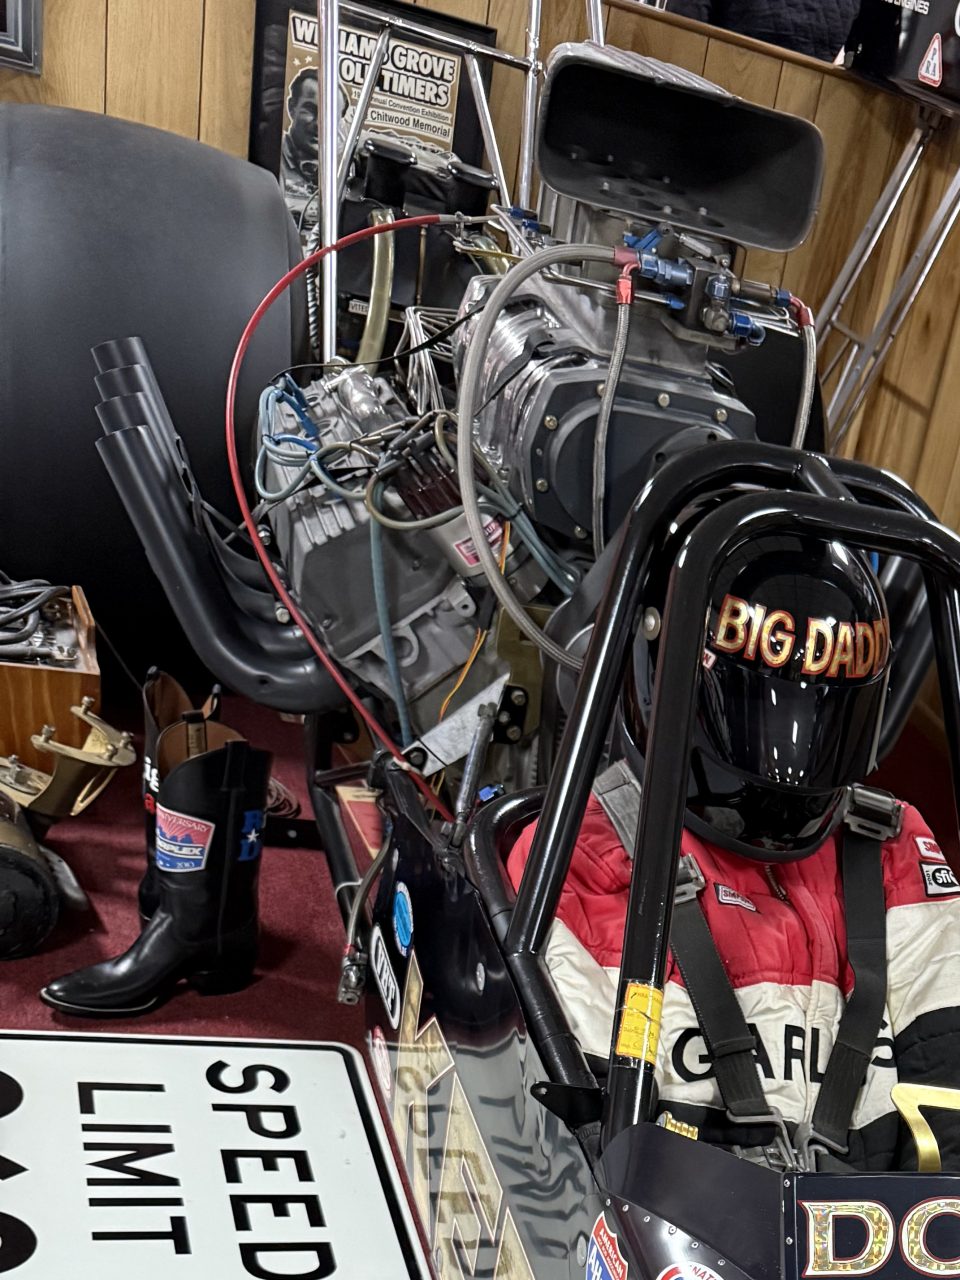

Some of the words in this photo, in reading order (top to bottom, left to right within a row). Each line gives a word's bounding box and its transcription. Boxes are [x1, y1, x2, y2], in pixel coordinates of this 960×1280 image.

[294, 16, 388, 64] WIIAM
[391, 44, 455, 82] GROVE
[381, 70, 449, 106] TIMERS
[388, 99, 421, 115] Convention
[370, 110, 410, 126] Chitwood
[412, 118, 450, 137] Memorial
[714, 594, 796, 668] BIG
[77, 1081, 192, 1254] LIMIT
[599, 1227, 624, 1279] AMERICAN
